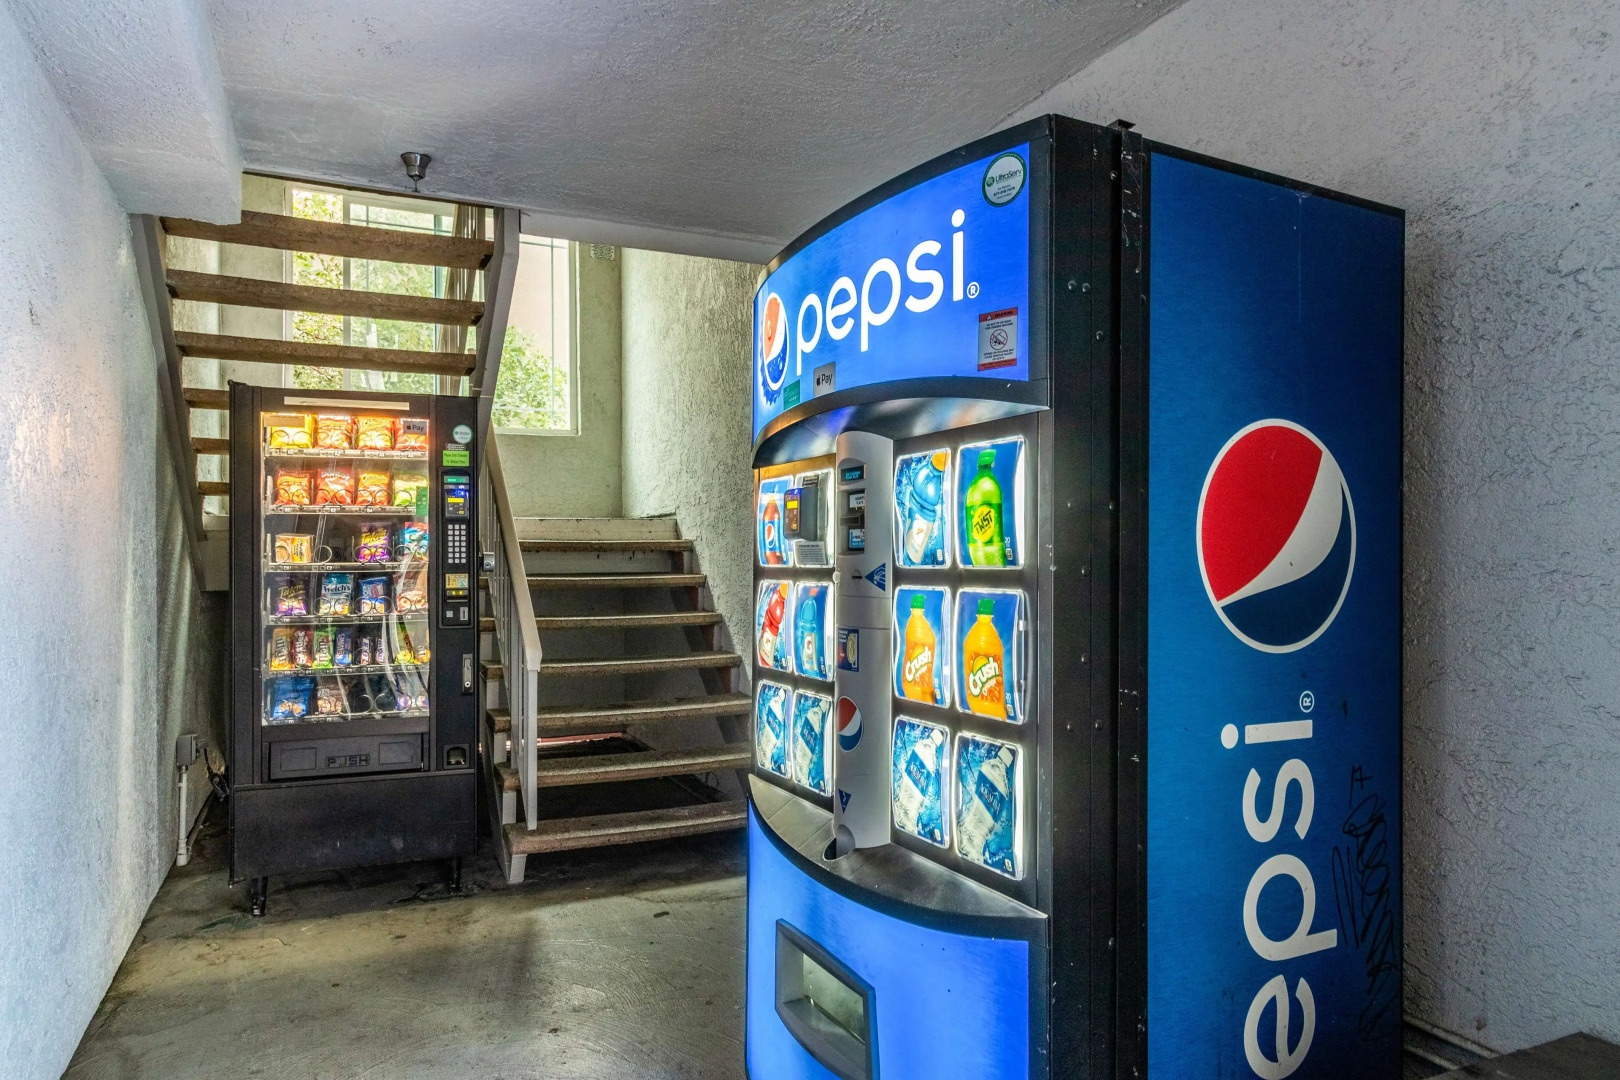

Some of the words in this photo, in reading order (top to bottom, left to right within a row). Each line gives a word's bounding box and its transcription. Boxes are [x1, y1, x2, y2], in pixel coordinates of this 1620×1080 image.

[821, 373, 833, 386] Pay
[411, 423, 425, 433] Pay
[361, 528, 387, 546] Takis
[323, 584, 350, 593] Welch's
[905, 646, 932, 683] Crush
[968, 656, 999, 697] Crush
[327, 755, 369, 768] PUSH
[1220, 719, 1338, 1080] epsi
